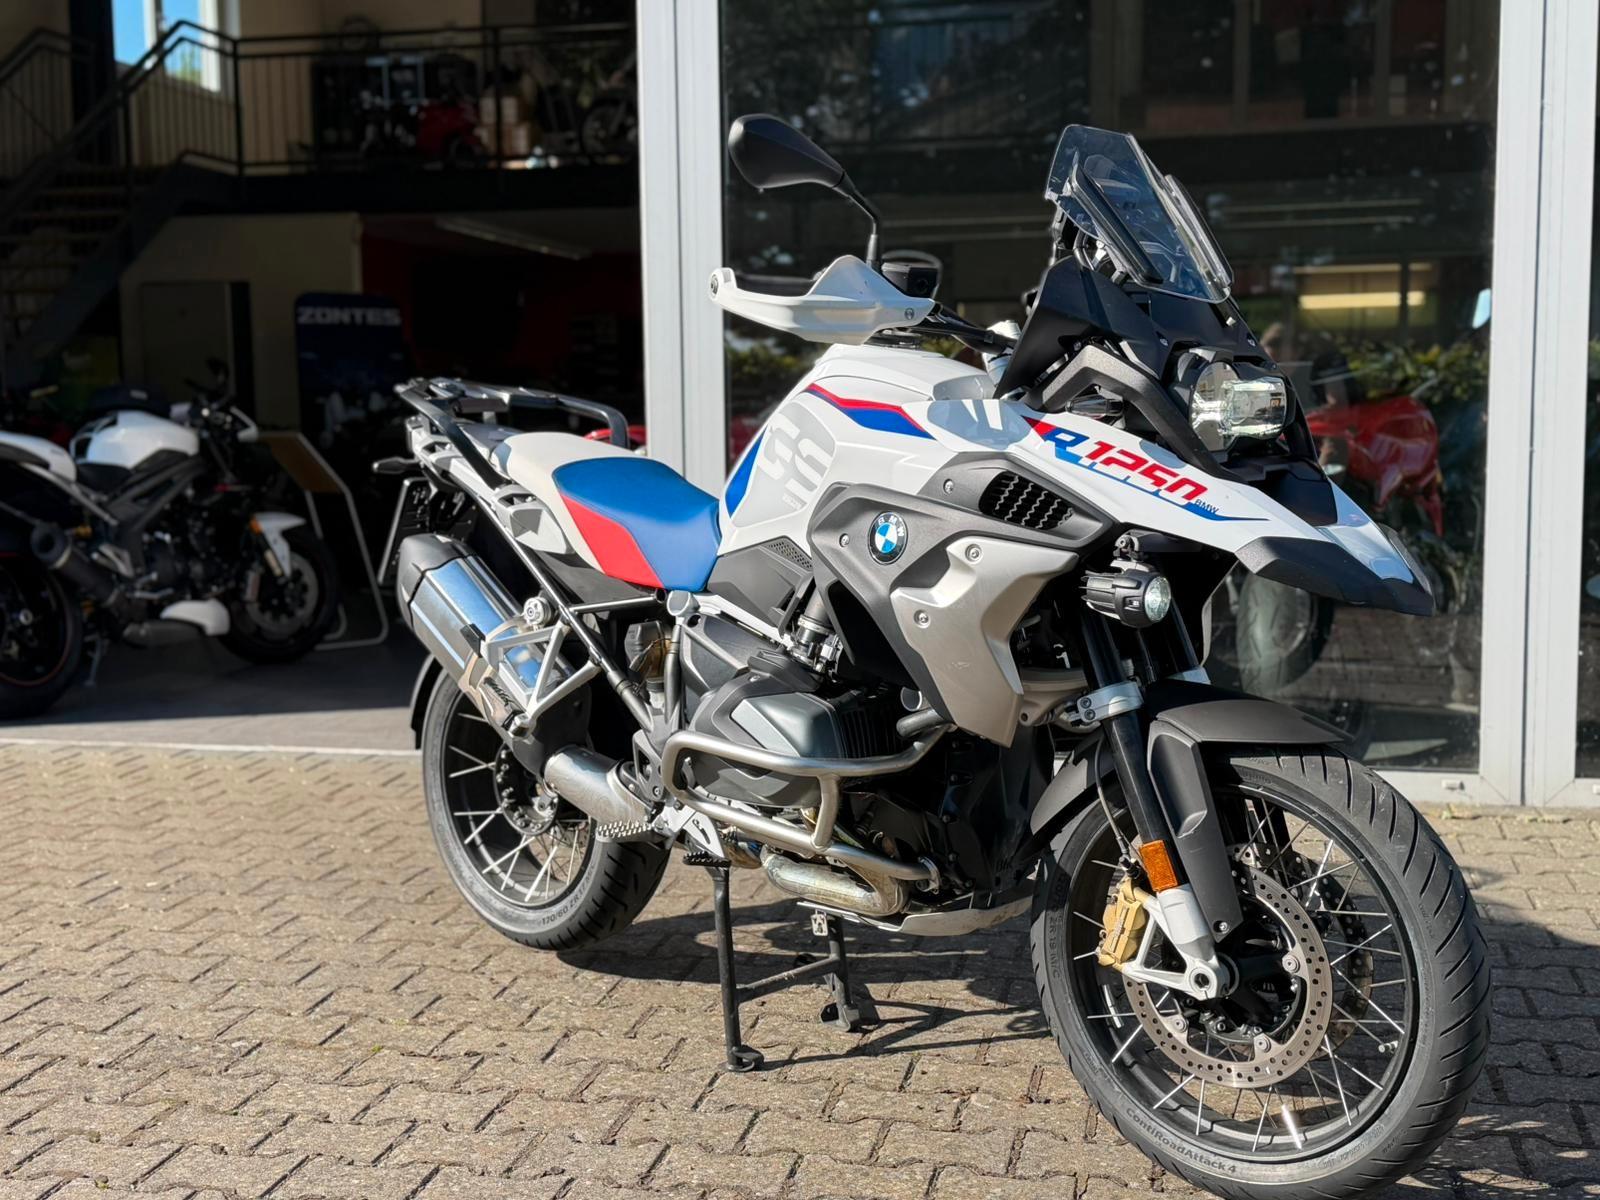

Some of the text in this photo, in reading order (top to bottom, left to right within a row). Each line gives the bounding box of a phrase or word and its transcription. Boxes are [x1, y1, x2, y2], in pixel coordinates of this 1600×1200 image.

[298, 306, 401, 326] ZONTES
[1194, 498, 1219, 514] BMW
[878, 515, 905, 537] BMW
[1126, 1107, 1237, 1175] ContiRoadAttack 4
